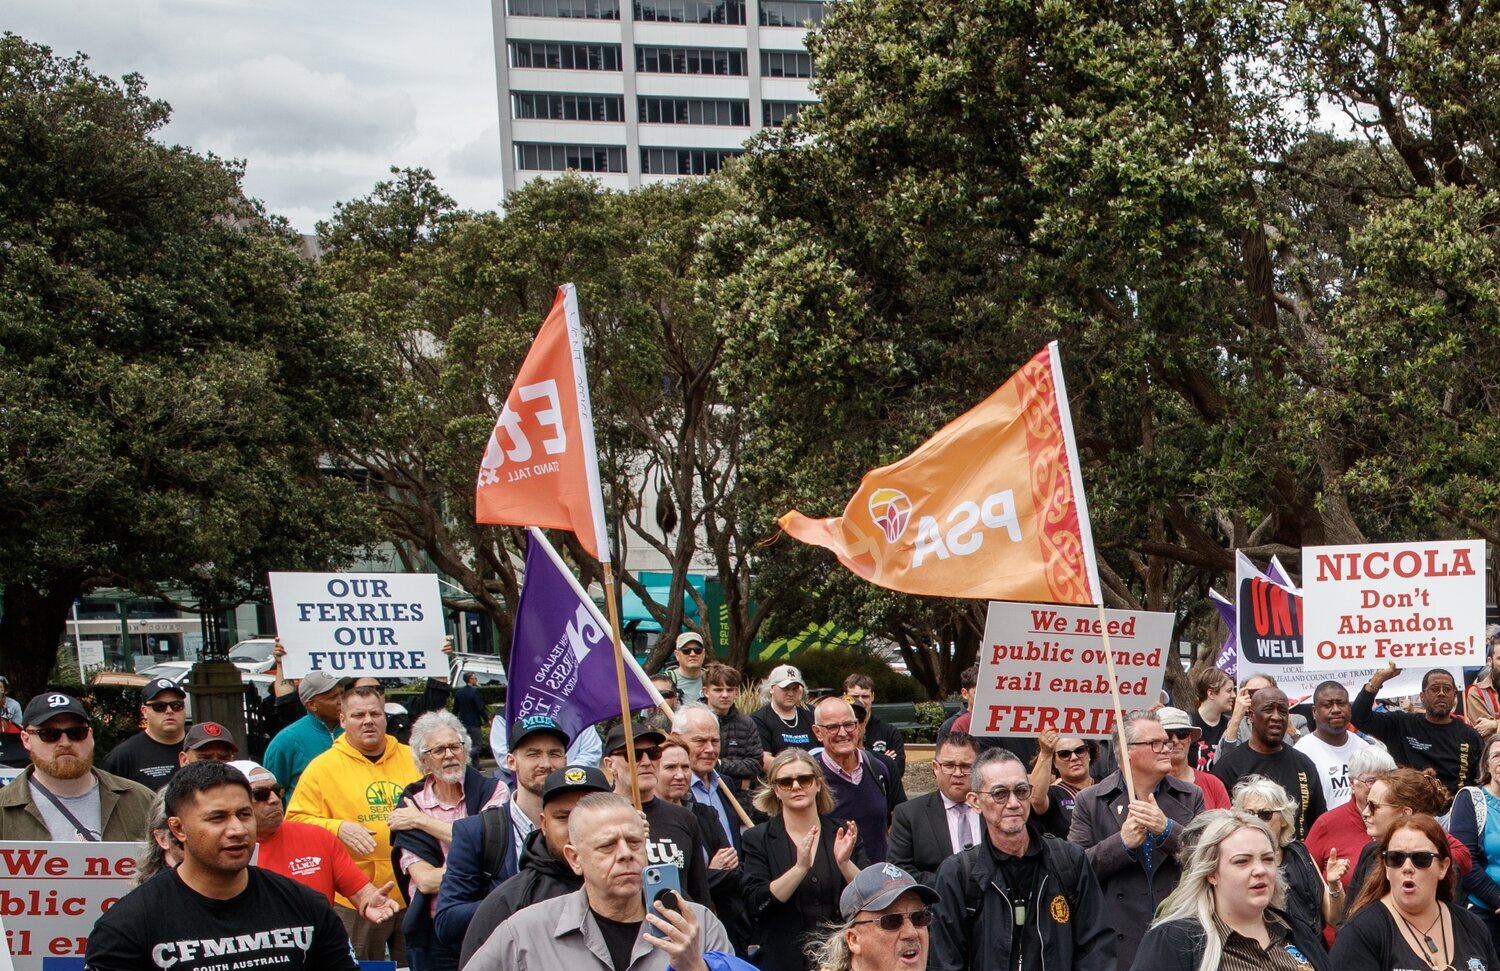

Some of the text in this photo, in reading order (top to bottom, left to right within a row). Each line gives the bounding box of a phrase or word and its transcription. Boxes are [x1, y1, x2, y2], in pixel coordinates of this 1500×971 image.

[1316, 548, 1476, 582] NICOLA
[327, 579, 391, 598] OUR
[1360, 587, 1430, 609] Don't
[297, 603, 424, 622] FERRIES
[1031, 610, 1136, 636] We need
[1337, 612, 1454, 635] Abandon
[334, 627, 398, 646] OUR
[1316, 635, 1475, 660] Our Ferries!
[308, 651, 426, 671] FUTURE
[991, 641, 1075, 665] public
[995, 672, 1042, 691] rail
[1305, 672, 1337, 681] COUNCIL
[1338, 671, 1348, 679] OF
[2, 850, 69, 877] We
[152, 925, 315, 971] CFMMEU
[233, 954, 291, 971] AUSTRALIA
